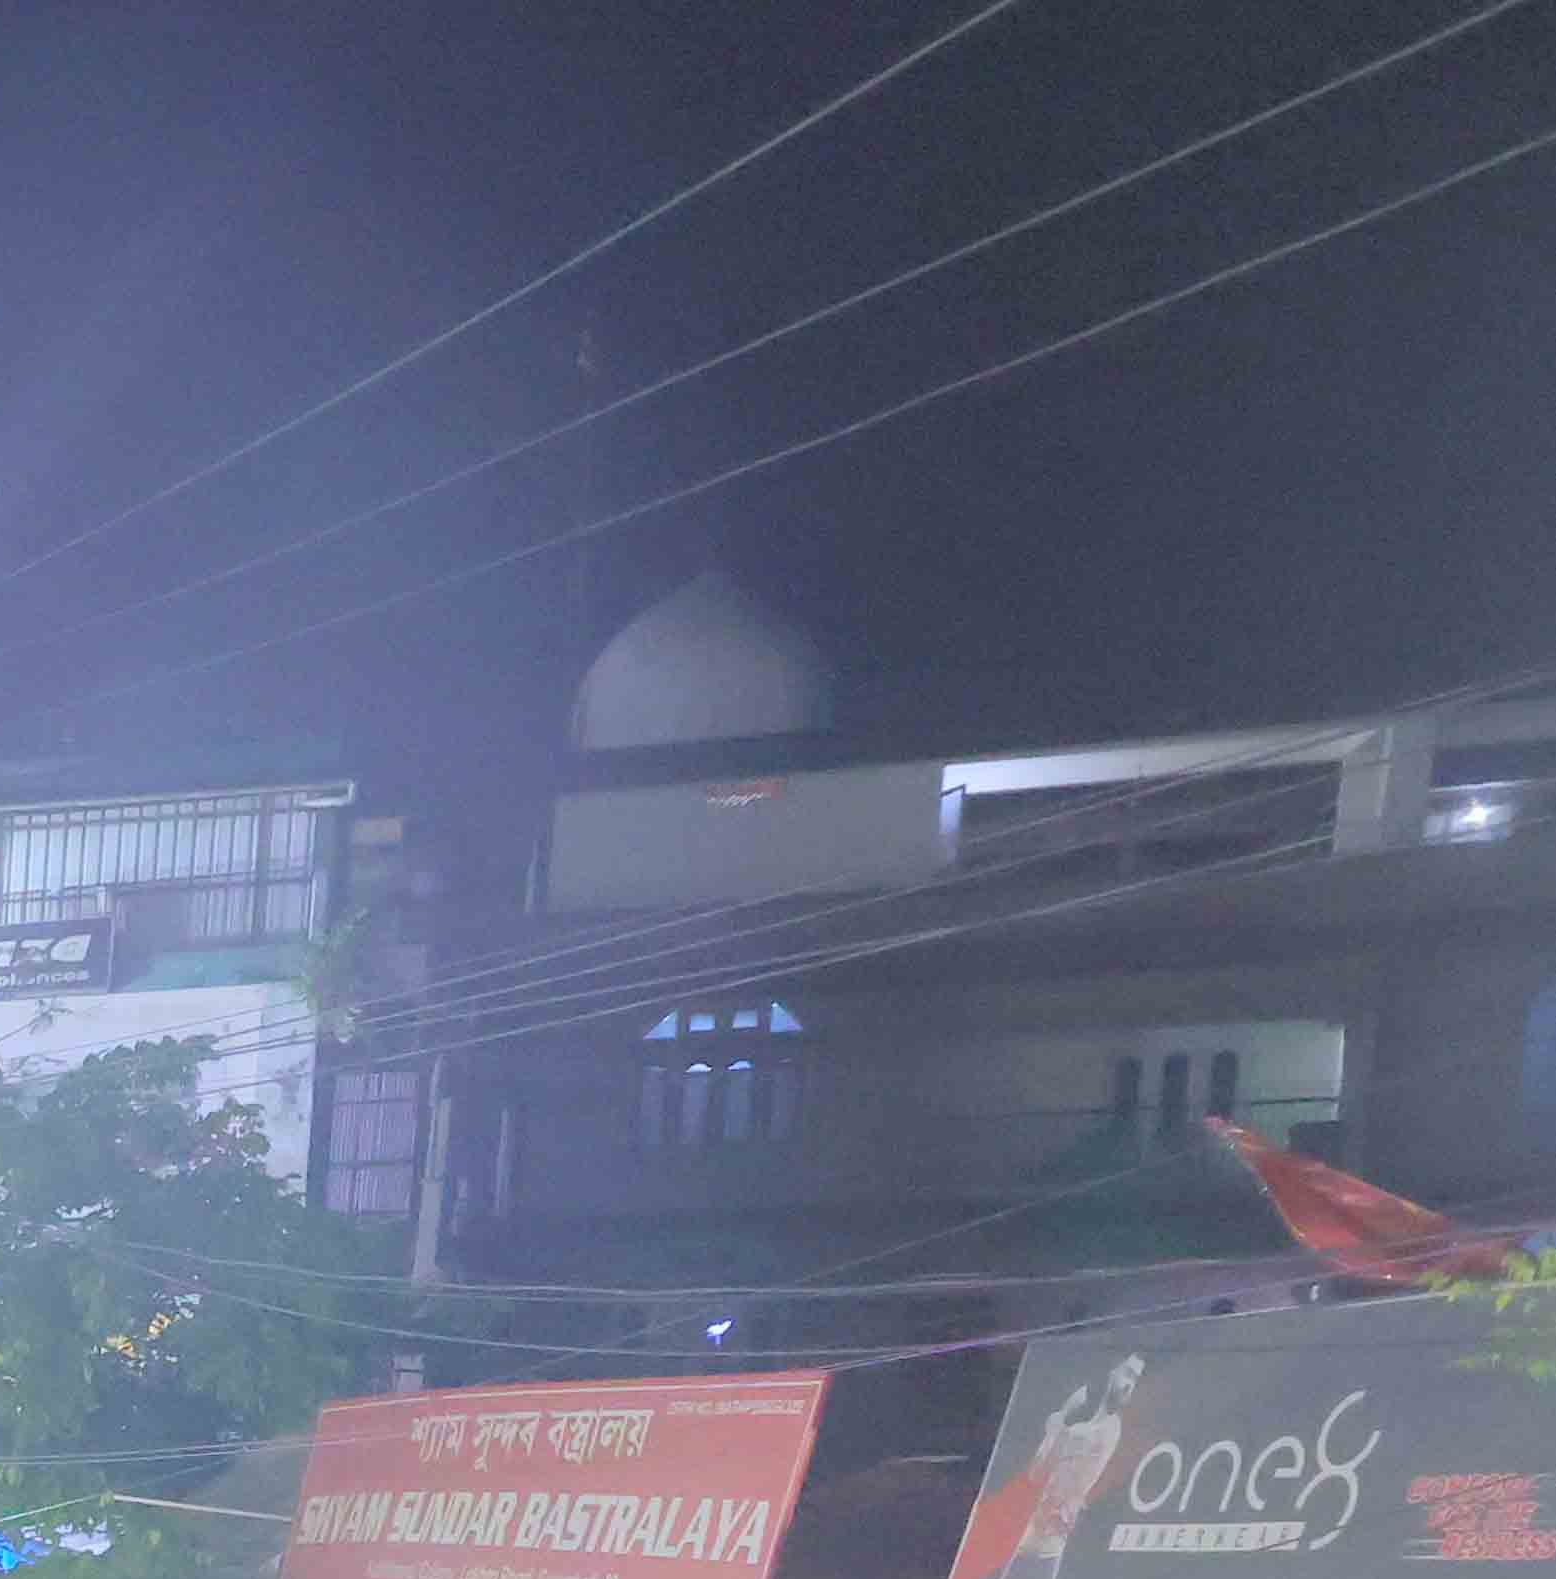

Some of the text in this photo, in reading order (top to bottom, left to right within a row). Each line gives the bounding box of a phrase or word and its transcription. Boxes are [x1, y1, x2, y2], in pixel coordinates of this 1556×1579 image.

[297, 1490, 770, 1566] SHYAM SUNDAR BASTRALAYA
